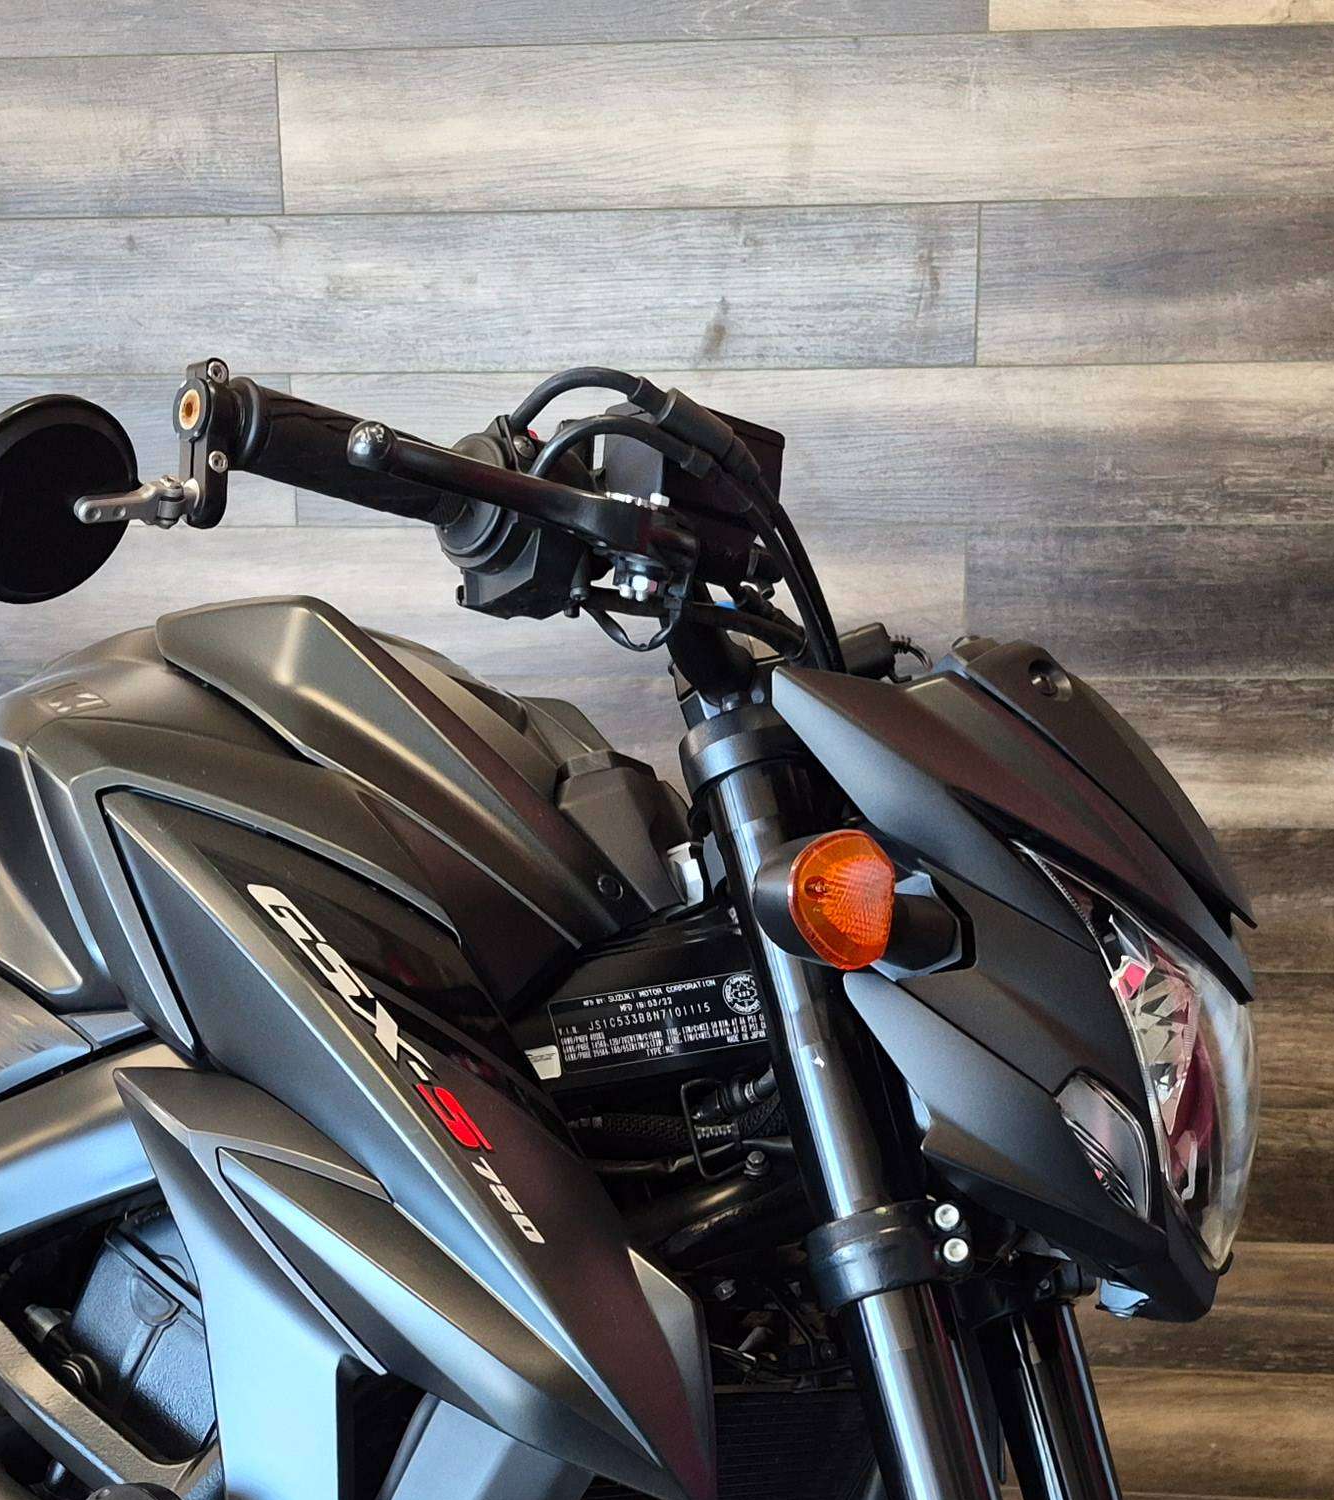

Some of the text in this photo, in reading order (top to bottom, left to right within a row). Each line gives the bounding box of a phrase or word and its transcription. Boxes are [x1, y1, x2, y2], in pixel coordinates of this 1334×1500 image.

[607, 991, 635, 1003] SUZUKI
[638, 987, 663, 998] MOTOR
[665, 979, 716, 993] CORPORATION
[470, 1156, 546, 1244] 750
